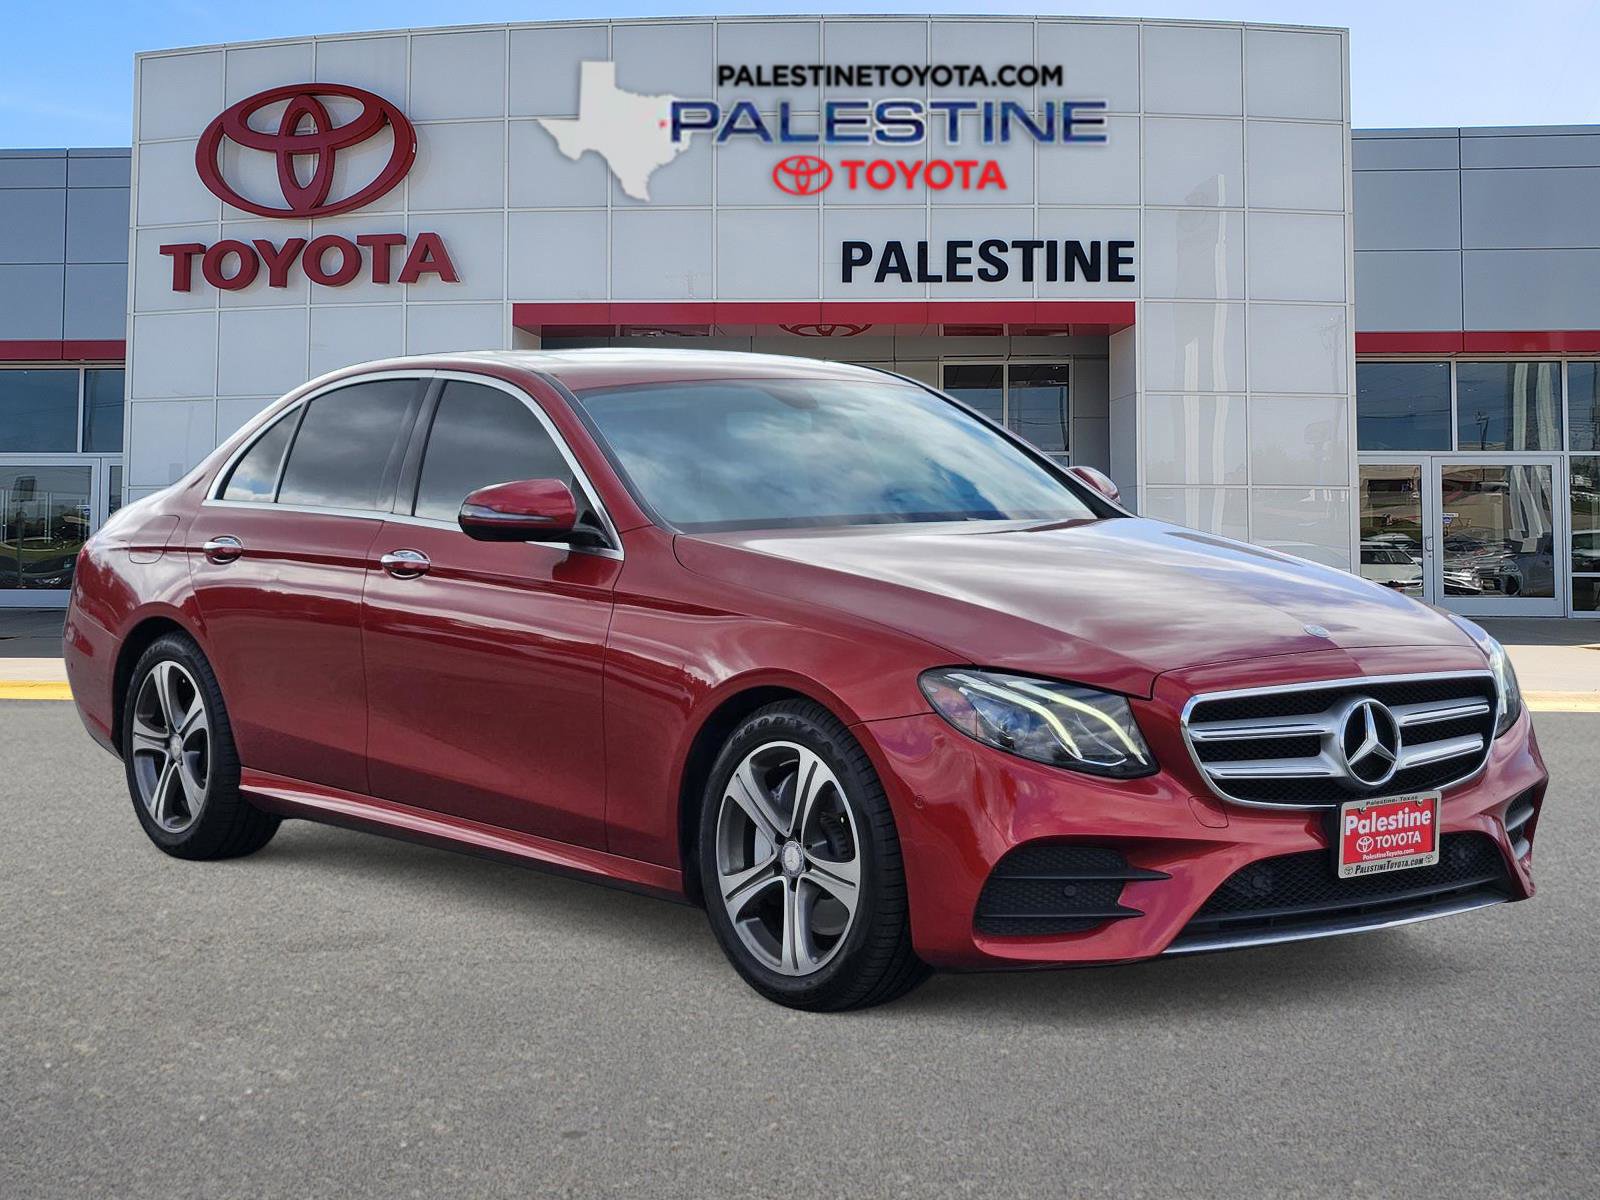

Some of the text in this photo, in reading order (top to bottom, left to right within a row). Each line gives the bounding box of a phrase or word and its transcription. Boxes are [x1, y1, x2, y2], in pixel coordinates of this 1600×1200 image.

[159, 231, 460, 292] TOYOTA
[842, 240, 1135, 283] PALESTINE
[1344, 806, 1432, 836] Palestine
[1375, 830, 1421, 848] TOYOTA
